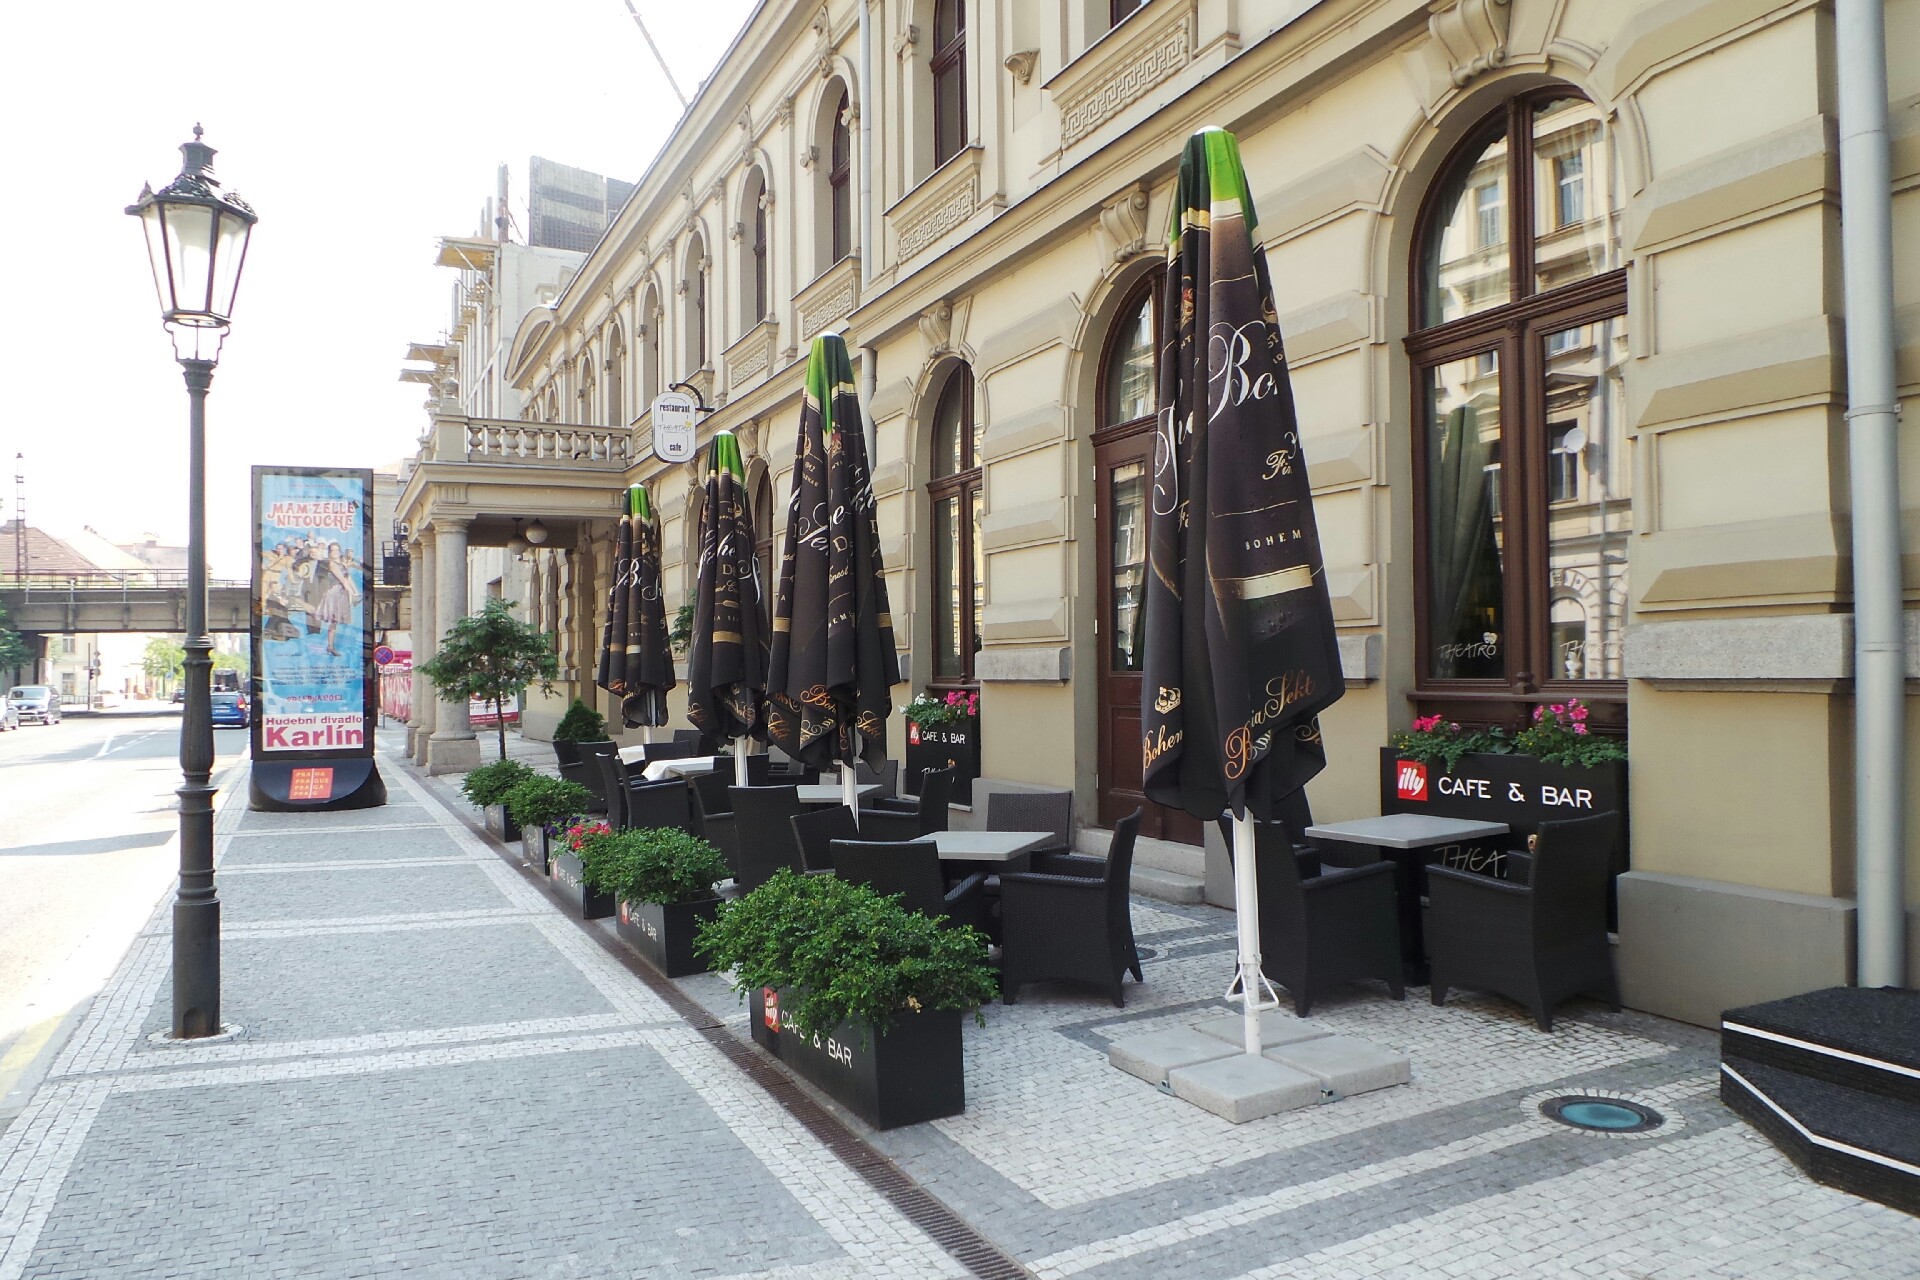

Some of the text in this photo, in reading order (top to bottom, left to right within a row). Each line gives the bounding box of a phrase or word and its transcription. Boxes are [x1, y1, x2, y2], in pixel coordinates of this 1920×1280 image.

[659, 404, 690, 414] restaurant
[276, 514, 353, 531] NITOUCHE
[1436, 642, 1497, 663] THEATRO
[266, 715, 363, 726] Hudební divadlo
[266, 725, 363, 747] Karlín
[922, 731, 966, 745] CAFE & BAR
[1399, 767, 1425, 796] illy
[1438, 777, 1593, 809] CAFE & BAR
[647, 922, 657, 942] BAR
[828, 1037, 852, 1069] BAR
